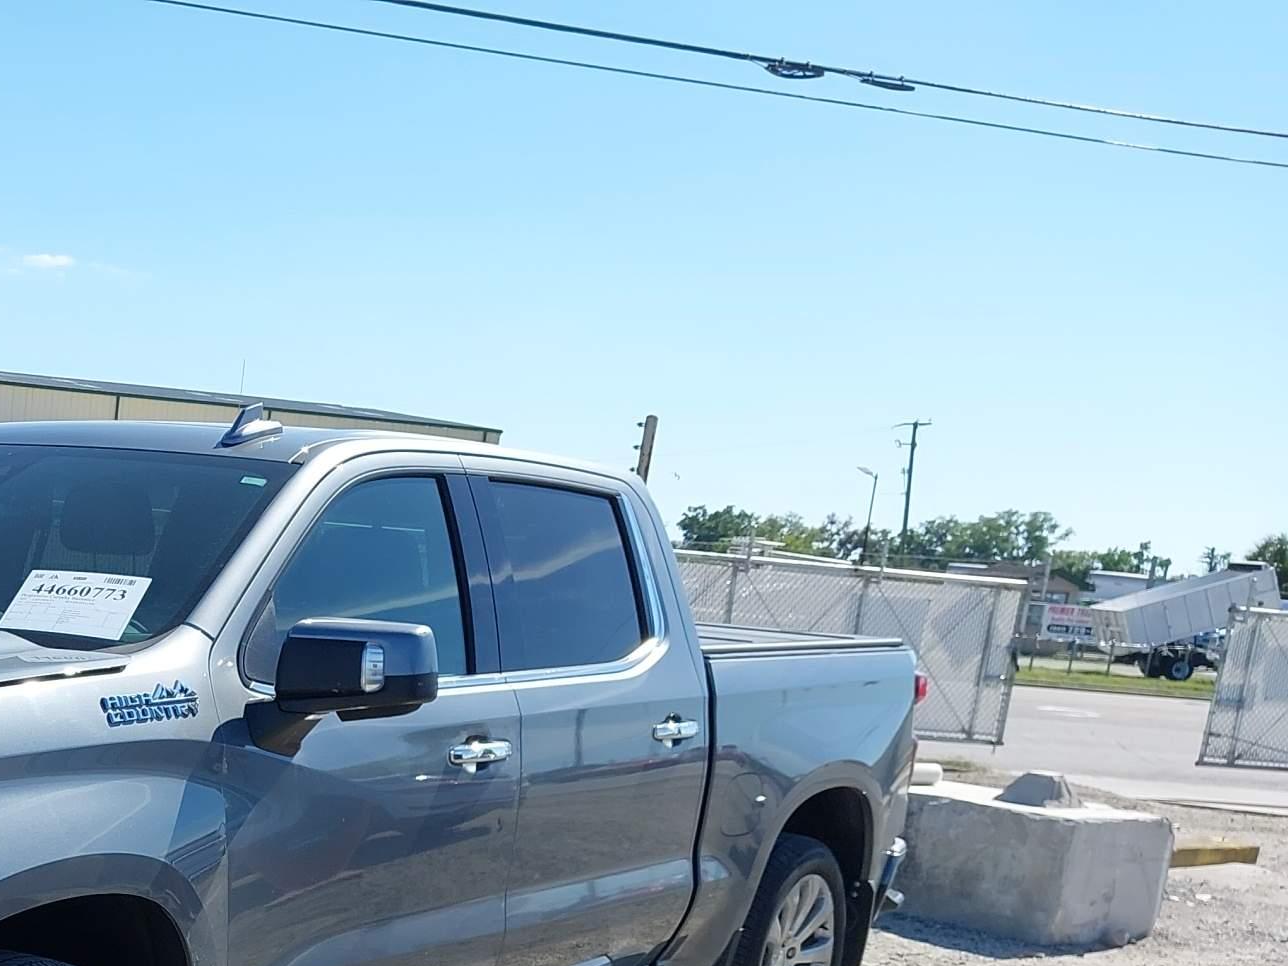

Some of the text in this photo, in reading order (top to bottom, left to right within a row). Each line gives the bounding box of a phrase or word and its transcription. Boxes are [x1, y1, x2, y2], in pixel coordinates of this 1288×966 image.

[32, 583, 127, 601] 44660773
[100, 693, 152, 712] HIGH
[107, 703, 199, 727] COUNTRY
